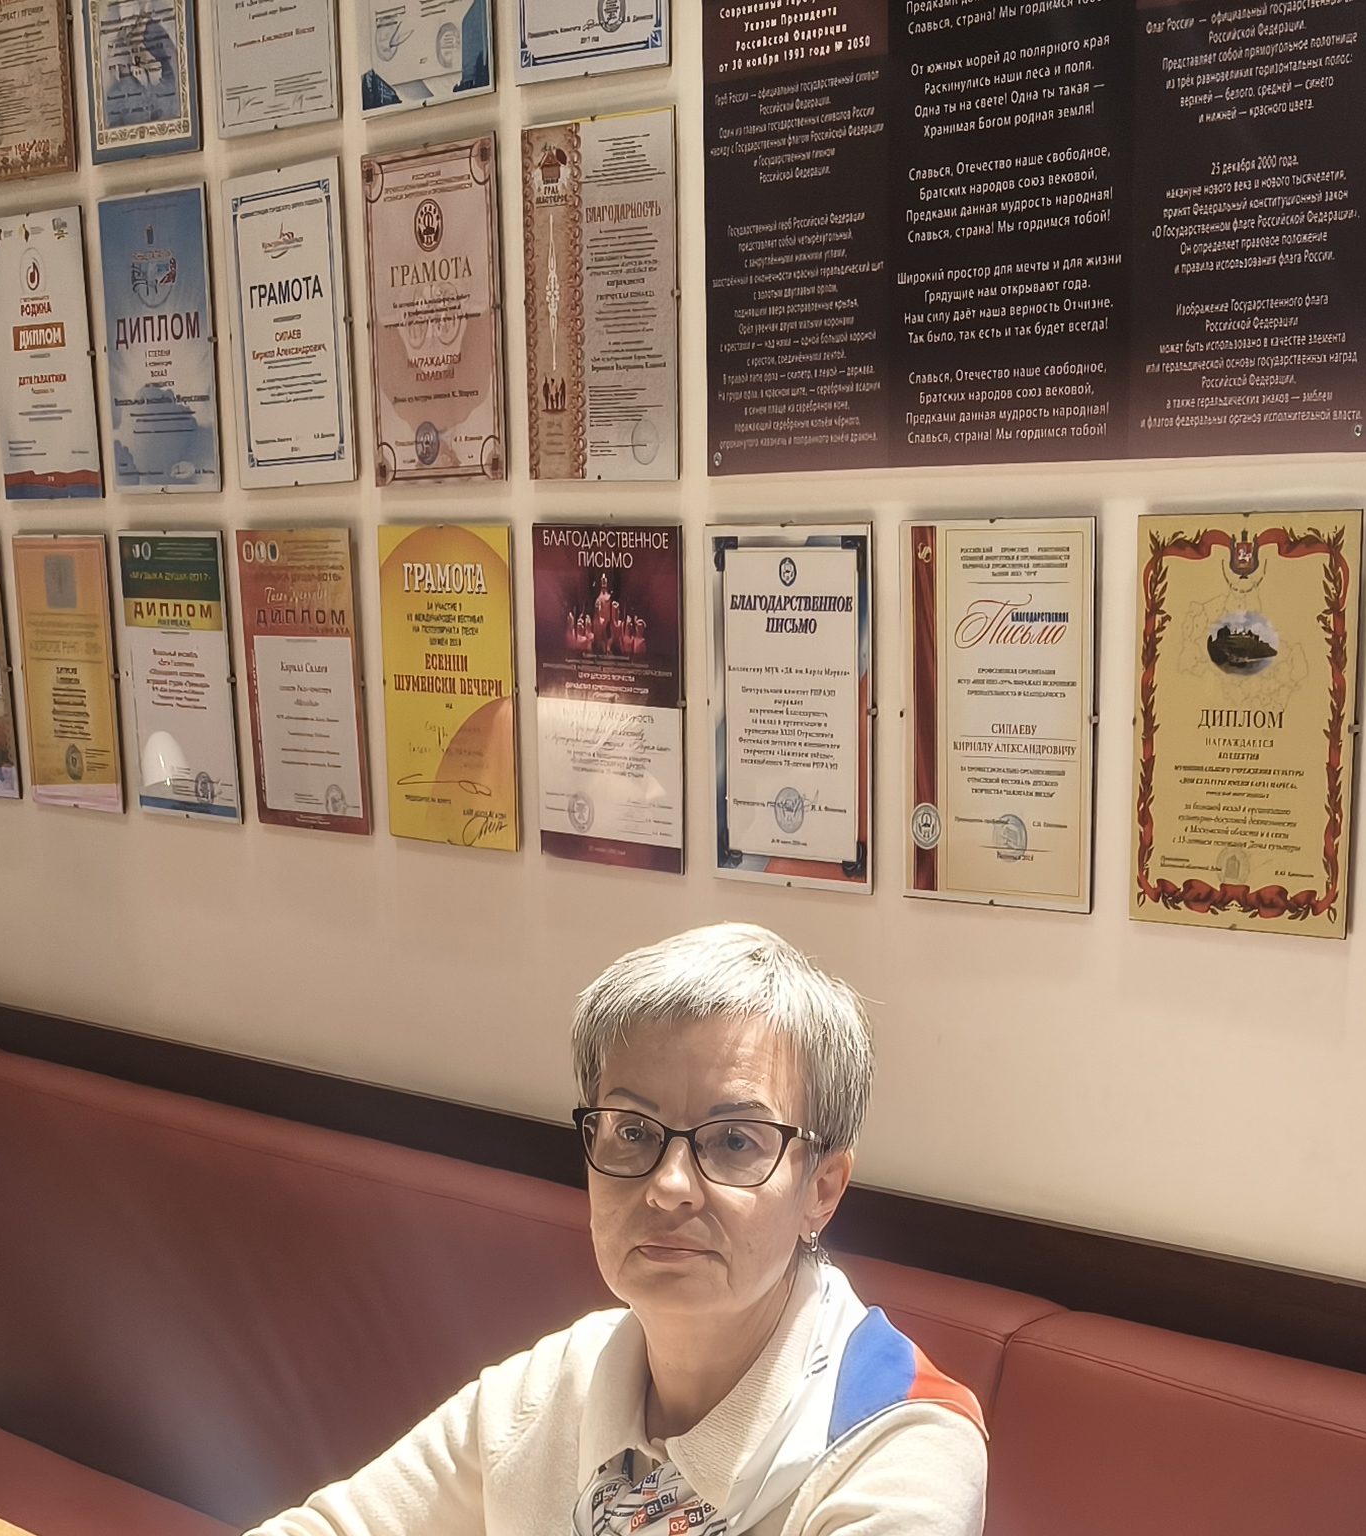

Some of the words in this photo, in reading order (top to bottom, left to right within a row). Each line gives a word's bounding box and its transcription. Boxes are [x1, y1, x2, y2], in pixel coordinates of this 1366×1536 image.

[581, 199, 662, 225] БЛАГОДАРНОСТЬ
[906, 207, 958, 225] Предками
[959, 202, 998, 218] данная
[1000, 197, 1052, 214] мудрость
[1055, 185, 1113, 207] народная!
[907, 229, 953, 243] Славься,
[955, 220, 994, 239] страна!
[997, 219, 1015, 233] Мы
[1018, 215, 1070, 233] гордимся
[1073, 208, 1111, 225] тобой!
[390, 255, 472, 289] ГРАМОТА
[249, 274, 324, 310] ГРАМОТА
[20, 301, 52, 317] РОДИНА
[19, 326, 62, 350] ДИПЛОМ
[111, 310, 200, 351] ДИПЛОМ
[542, 529, 669, 550] БЛАГОДАРСТВЕННОЕ
[577, 550, 634, 569] ПИСЬМО
[402, 562, 488, 597] ГРАМОТА
[130, 599, 213, 623] ДИПЛОМ
[729, 594, 853, 614] БЛАГОДАРСТВЕННОЕ
[256, 608, 346, 629] ДИПЛОМ
[765, 616, 818, 635] ПИСЬМО
[954, 593, 1067, 649] Письмо
[393, 673, 457, 695] ШУМЕНСКИ
[459, 677, 508, 701] ВЕЧЕРИ
[991, 723, 1038, 736] СИЛАЕВУ
[1197, 709, 1285, 729] ДИПЛОМ
[660, 1490, 675, 1506] 18
[646, 1502, 661, 1517] 19
[687, 1510, 704, 1525] 19
[631, 1513, 647, 1529] 20
[669, 1518, 687, 1532] 20
